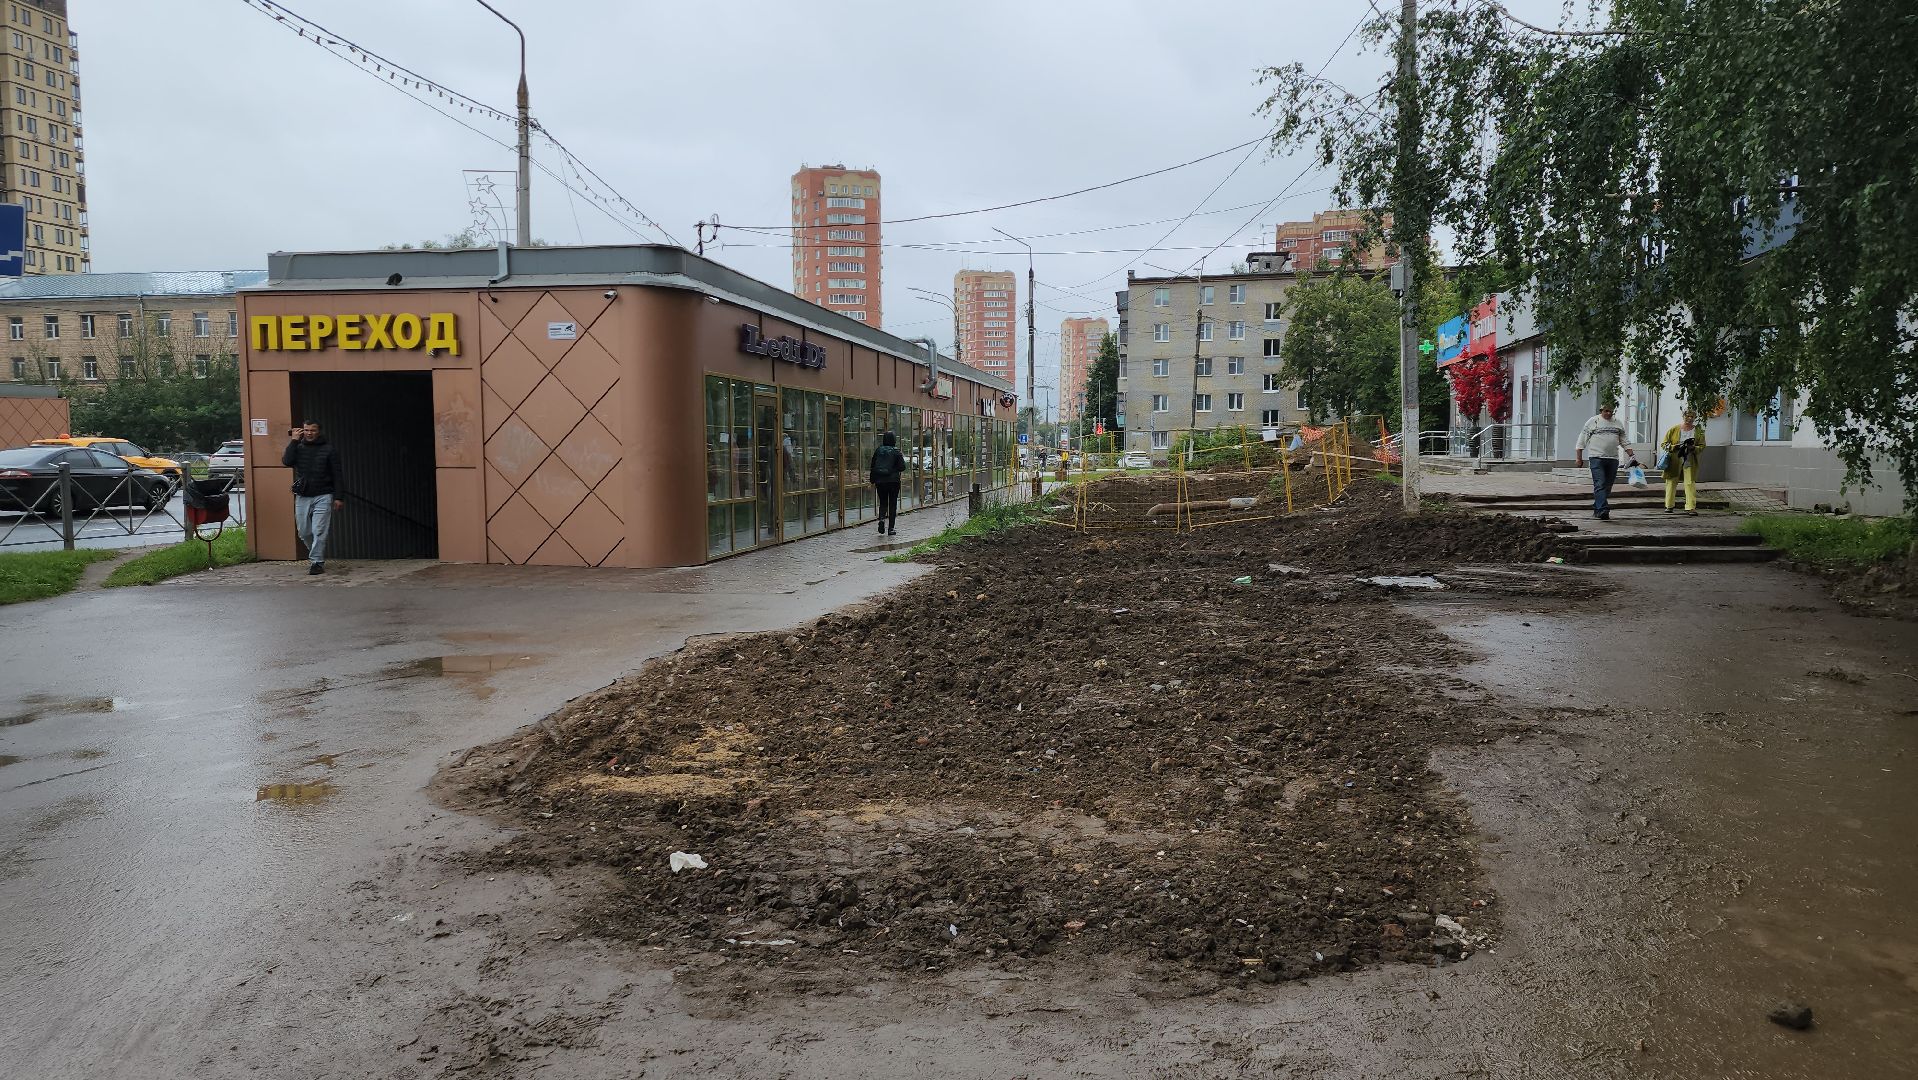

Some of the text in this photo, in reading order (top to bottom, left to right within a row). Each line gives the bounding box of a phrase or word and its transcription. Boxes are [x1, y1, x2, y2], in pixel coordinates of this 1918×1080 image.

[250, 312, 461, 356] ПЕРЕХОД
[743, 323, 827, 370] Ledi Di
